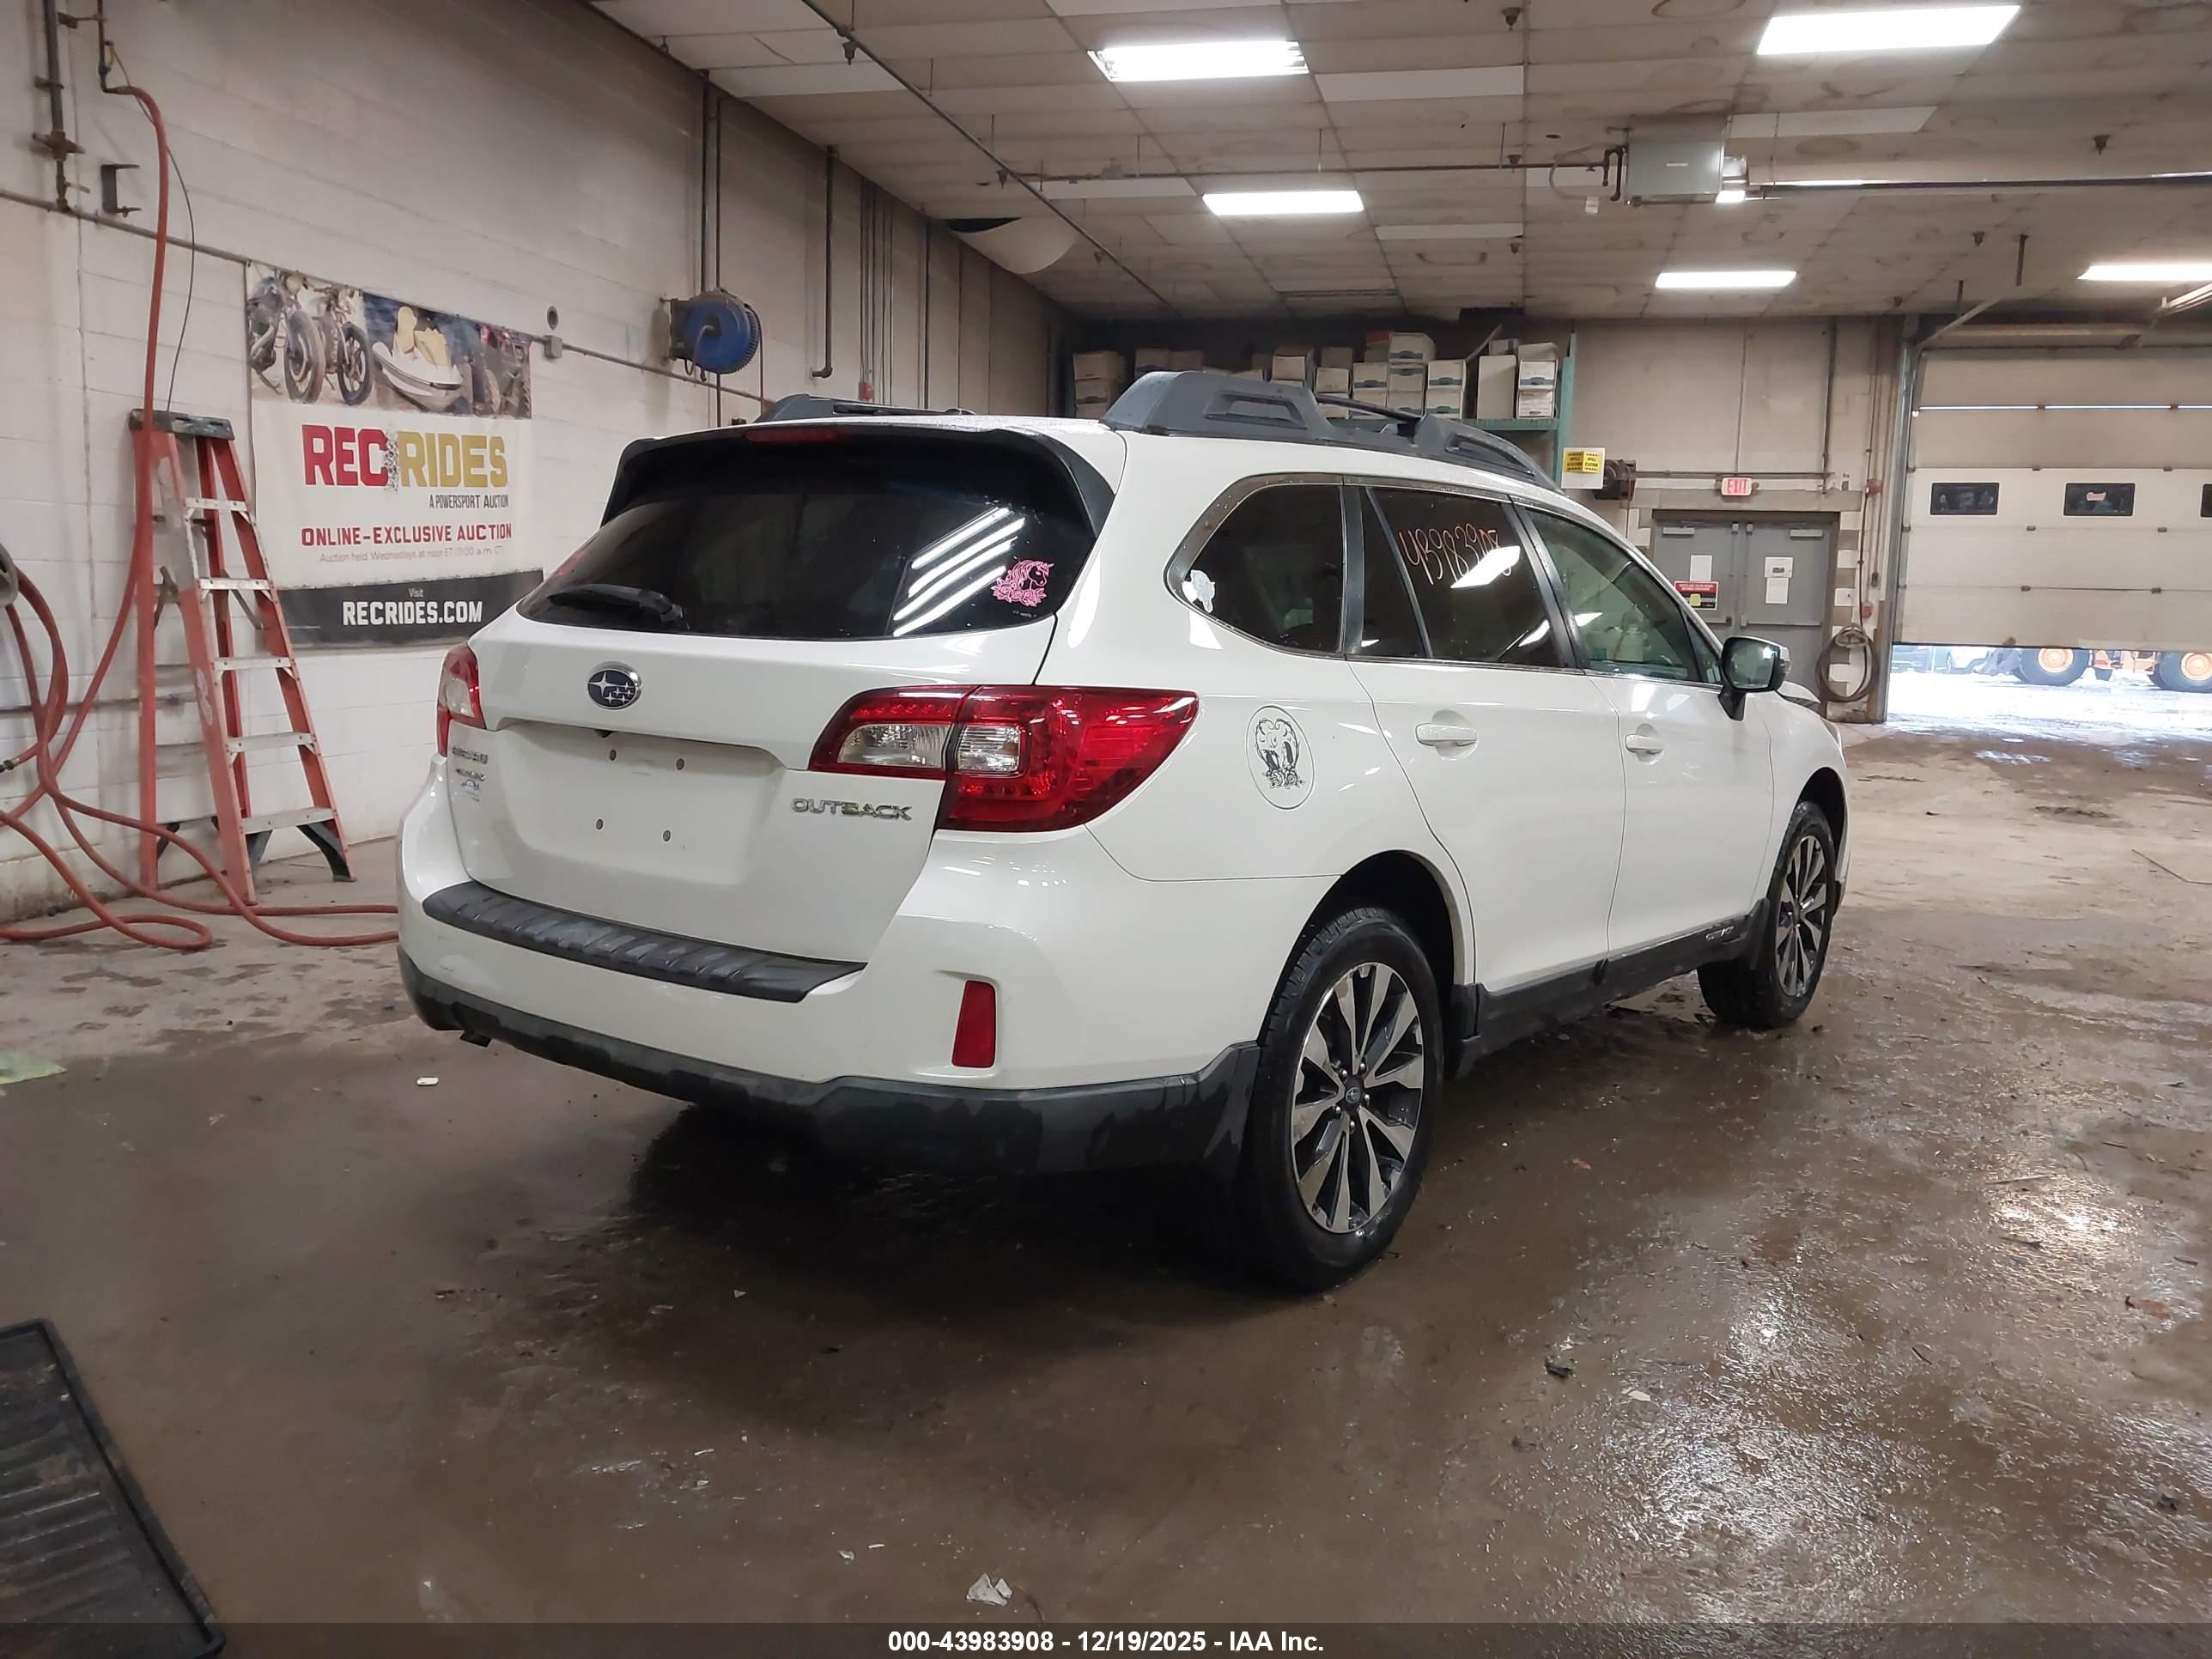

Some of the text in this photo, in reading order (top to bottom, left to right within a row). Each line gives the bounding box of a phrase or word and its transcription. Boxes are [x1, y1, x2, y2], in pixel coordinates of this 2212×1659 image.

[1728, 479, 1748, 494] EXIT
[429, 494, 509, 509] A POWERSPORT AUCTION
[301, 523, 513, 547] ONLINE-EXCLUSIVE AUCTION
[319, 552, 350, 562] Auction
[351, 551, 368, 562] held
[408, 587, 423, 598] Visit
[343, 600, 483, 626] RECRIDES.COM
[792, 798, 912, 821] OUTBACK
